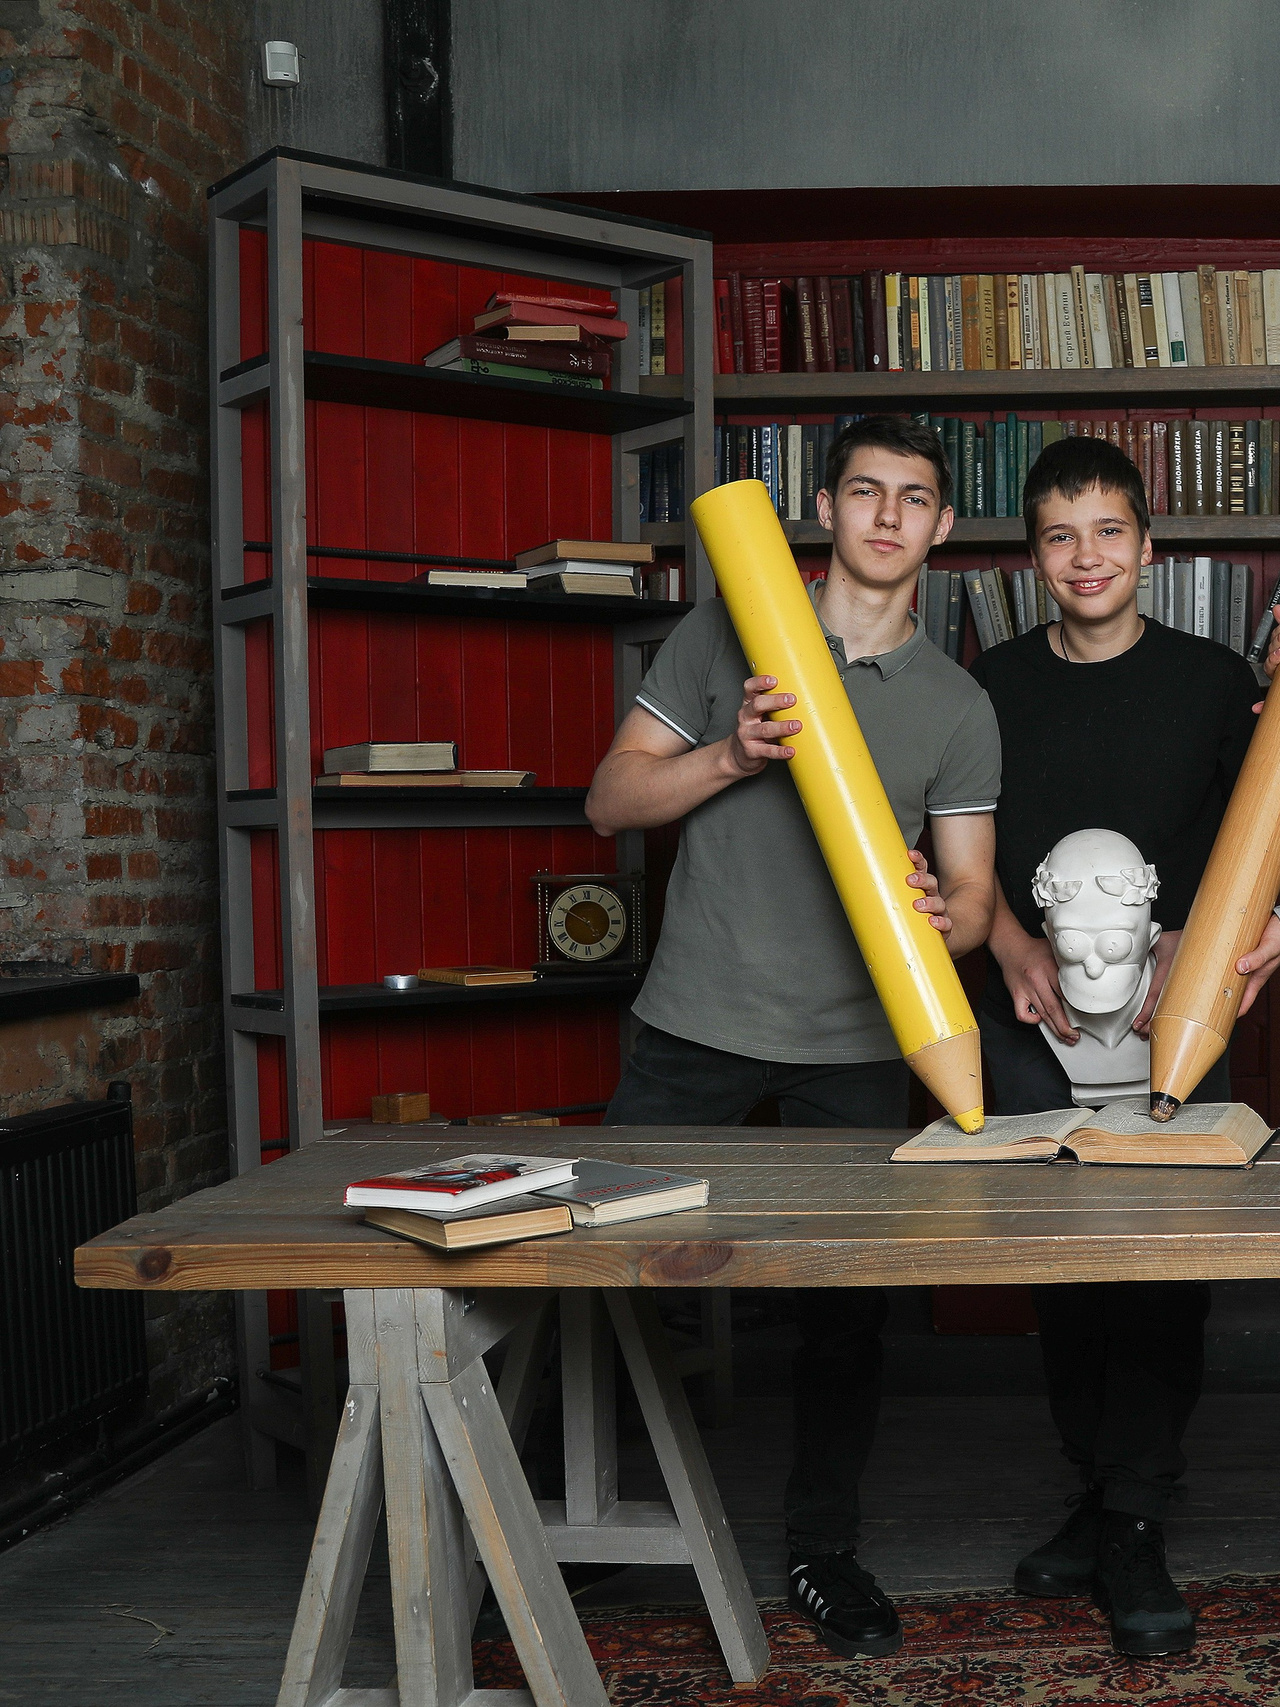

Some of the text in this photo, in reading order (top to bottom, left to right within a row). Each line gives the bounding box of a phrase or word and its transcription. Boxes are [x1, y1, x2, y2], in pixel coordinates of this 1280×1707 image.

[984, 289, 994, 358] ГРЭМ ГРИН
[1063, 292, 1075, 363] Сергей Есенин
[1226, 306, 1234, 341] ПОЛЕВОЙ
[1228, 342, 1236, 364] БОРИС
[964, 426, 974, 471] ЛУКОНИН
[1177, 500, 1182, 508] 1
[1196, 499, 1203, 507] 5
[1216, 500, 1223, 508] 4
